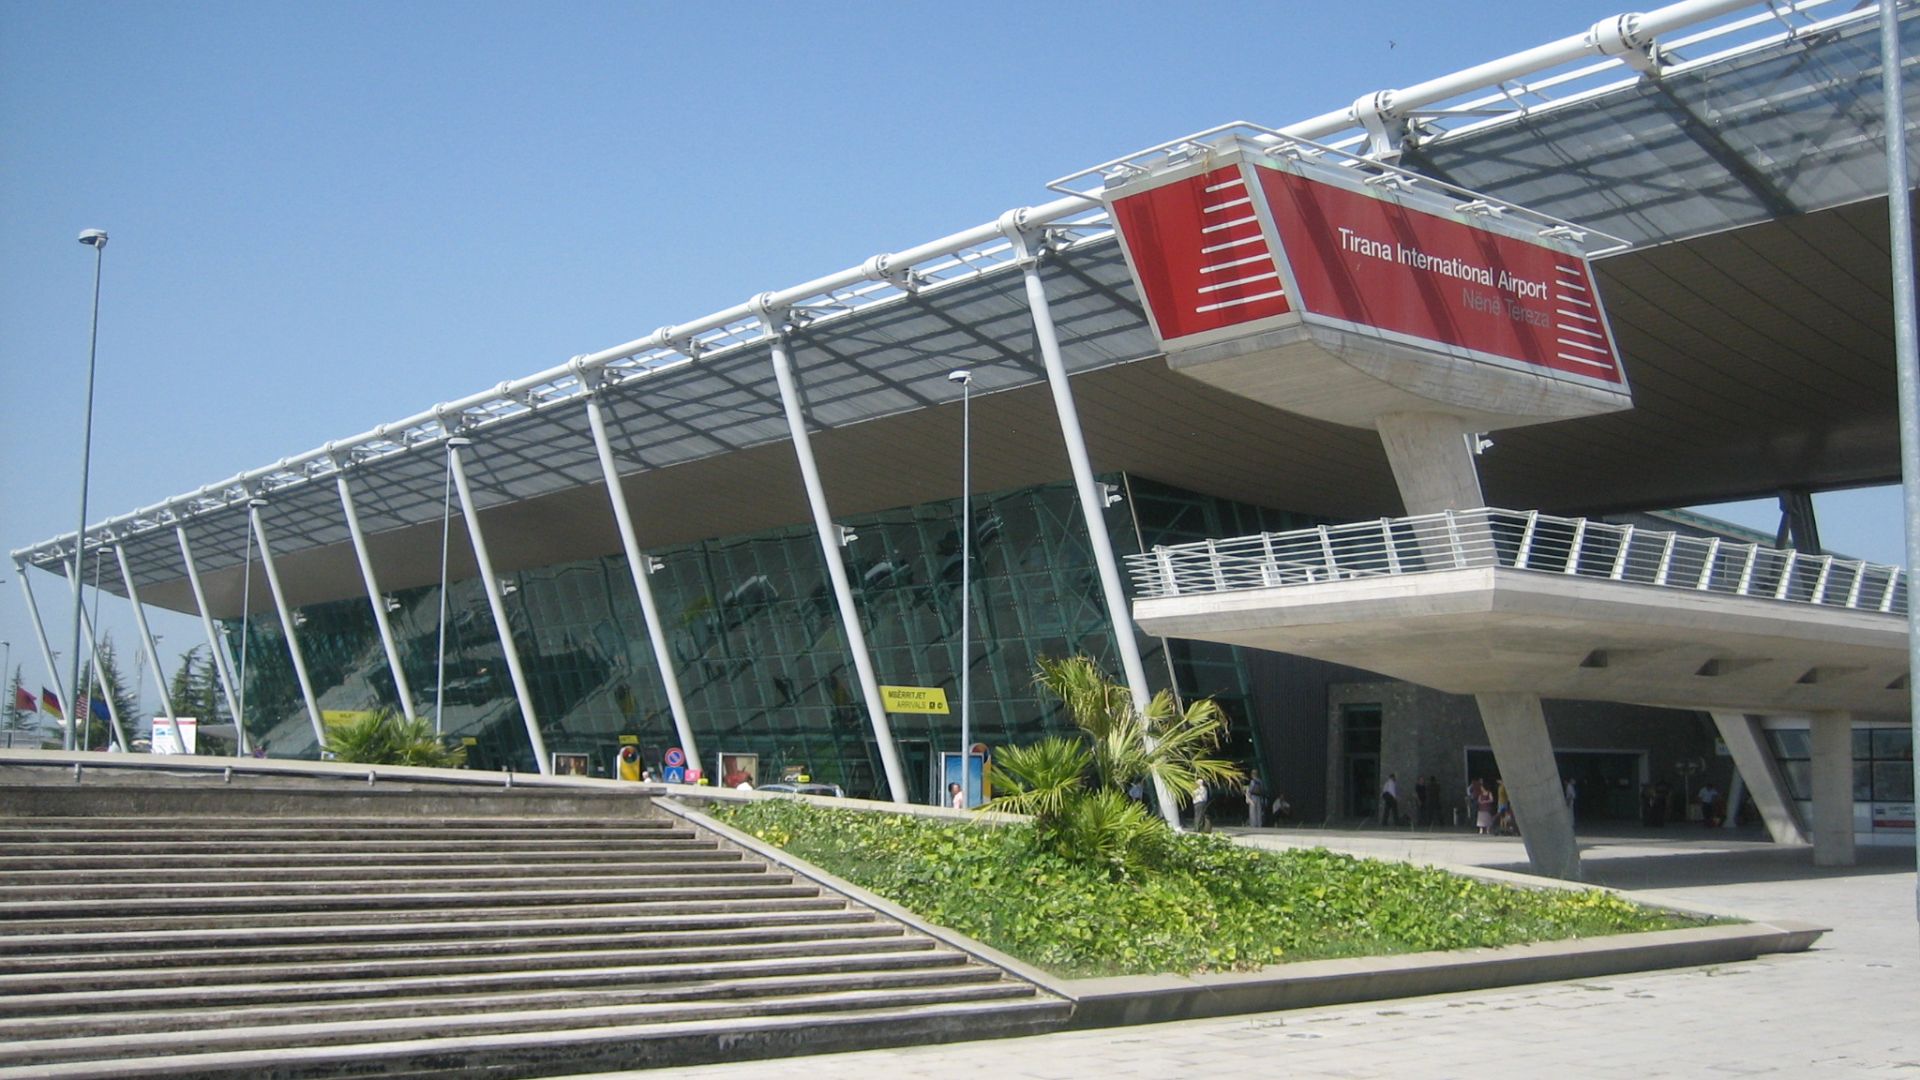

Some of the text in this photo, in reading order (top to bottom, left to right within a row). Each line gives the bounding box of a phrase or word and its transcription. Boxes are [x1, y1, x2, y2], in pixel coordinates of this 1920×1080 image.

[1338, 227, 1547, 300] Tirana International Airport
[1462, 287, 1550, 328] Nënë Tereza
